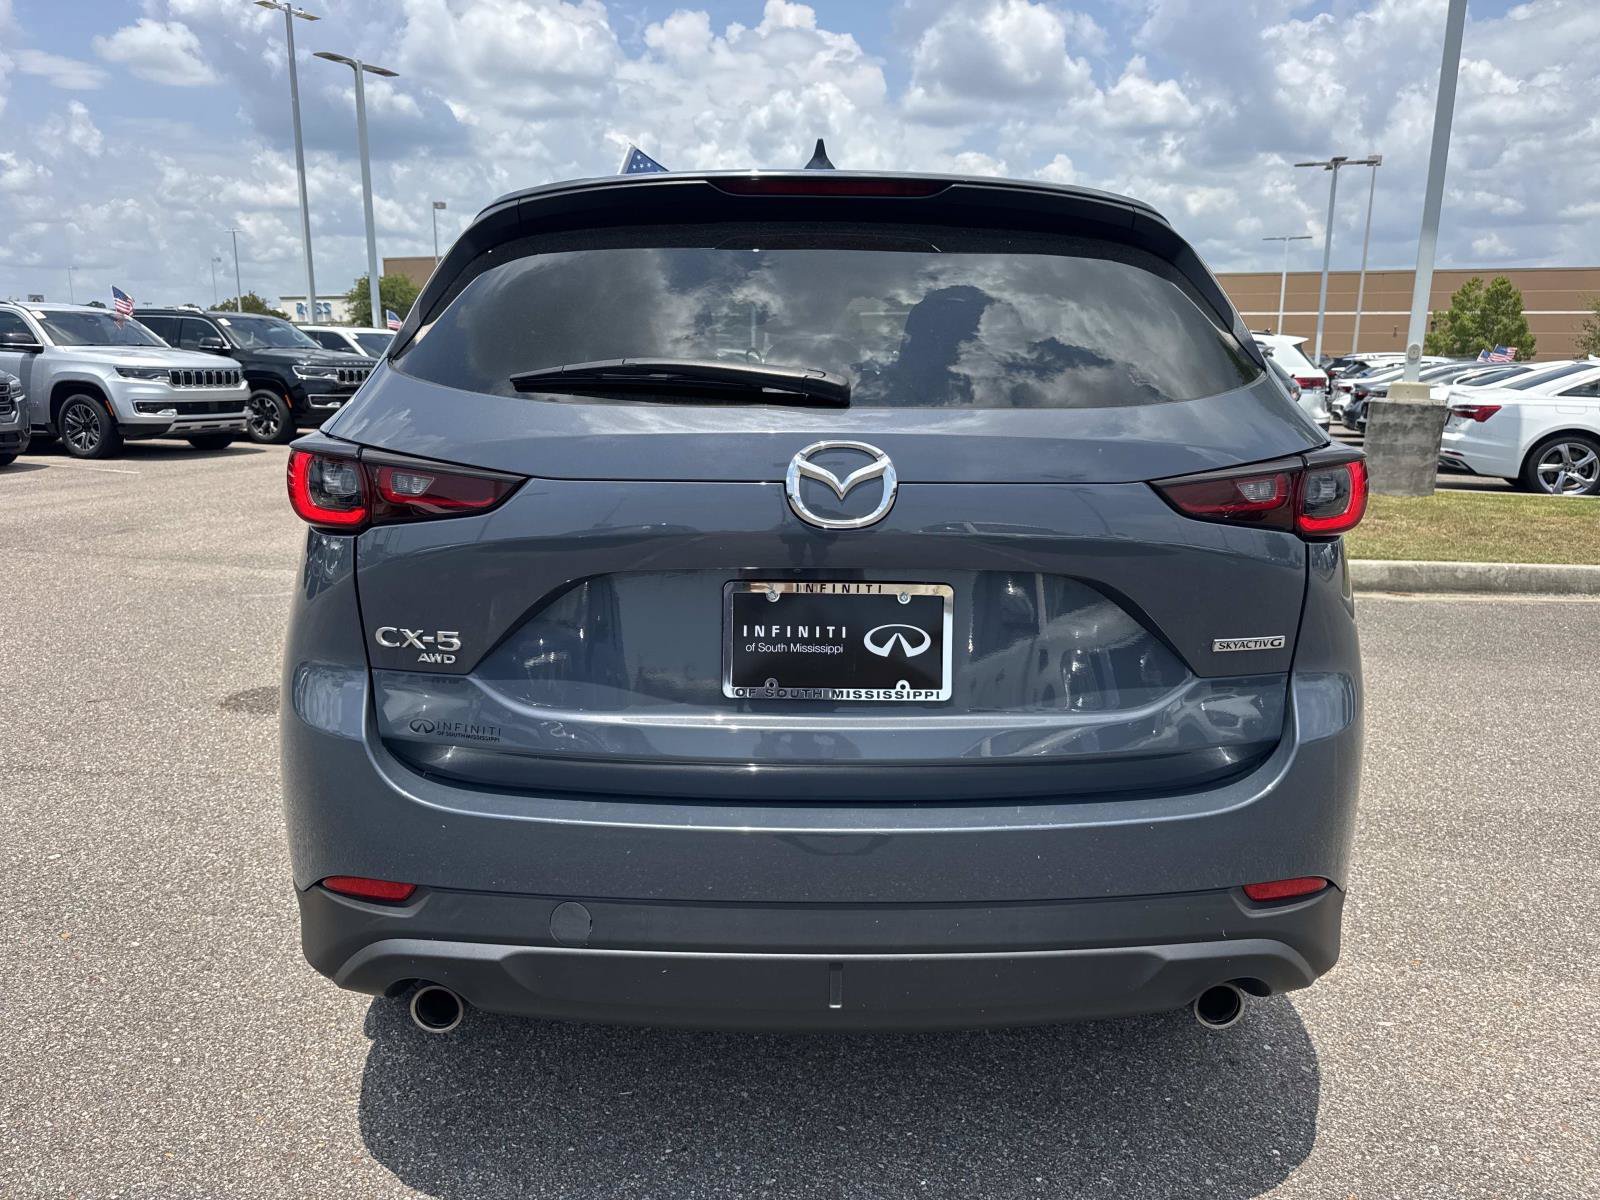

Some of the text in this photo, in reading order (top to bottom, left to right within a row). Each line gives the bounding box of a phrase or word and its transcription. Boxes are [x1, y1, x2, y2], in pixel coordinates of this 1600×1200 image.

[296, 302, 332, 314] RSS
[796, 583, 883, 594] INFINITI
[743, 625, 846, 639] INFINITI
[375, 626, 462, 651] CX-5
[745, 642, 844, 654] of South Mississippi
[418, 653, 456, 664] AWD
[735, 688, 941, 700] OF SOUTH MISSISSIPPI
[436, 721, 501, 736] INFINITI
